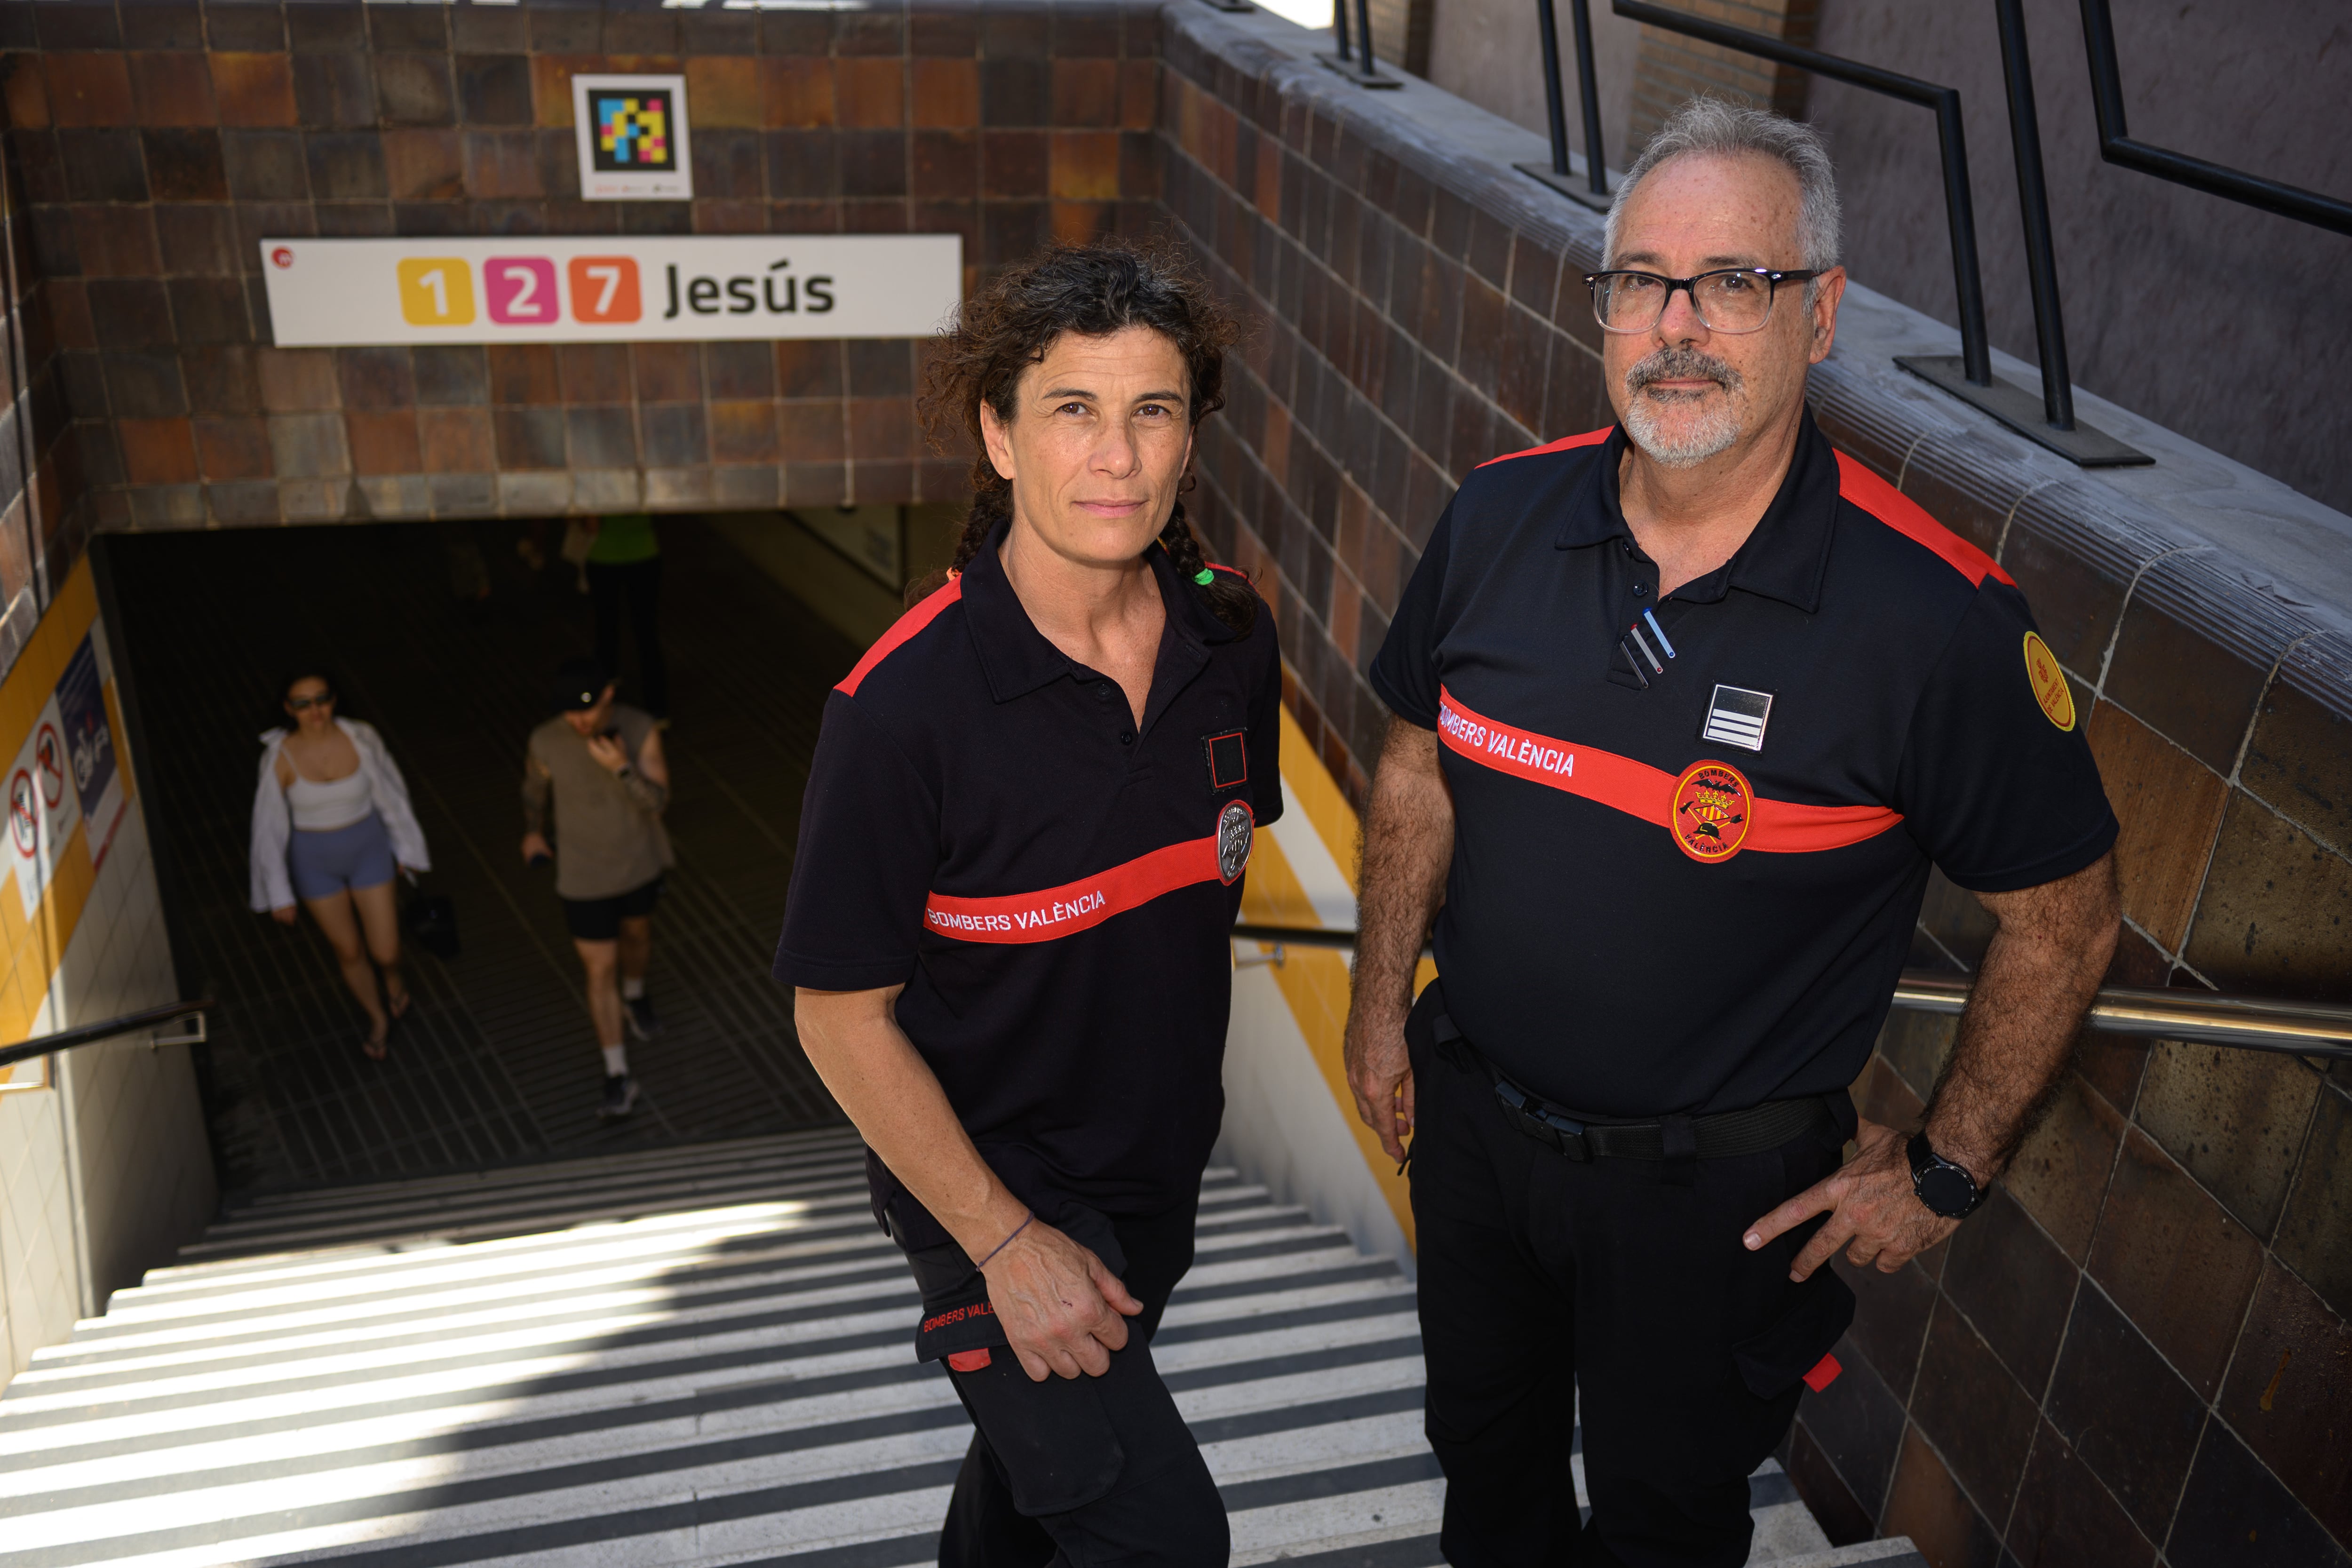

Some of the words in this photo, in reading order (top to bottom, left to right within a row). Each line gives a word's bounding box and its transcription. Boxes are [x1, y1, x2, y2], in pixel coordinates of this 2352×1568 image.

[418, 269, 448, 316] 1
[502, 266, 541, 316] 2
[585, 266, 621, 316] 7
[662, 259, 835, 320] Jesús
[1487, 730, 1574, 777] VALÈNCIA
[1698, 769, 1739, 787] BOMBERS
[1685, 833, 1729, 853] VALÈNCIA
[927, 907, 1012, 931] BOMBERS
[1014, 890, 1106, 930] VALÈNCIA
[924, 1307, 965, 1333] BOMBERS
[967, 1301, 994, 1318] VALE
